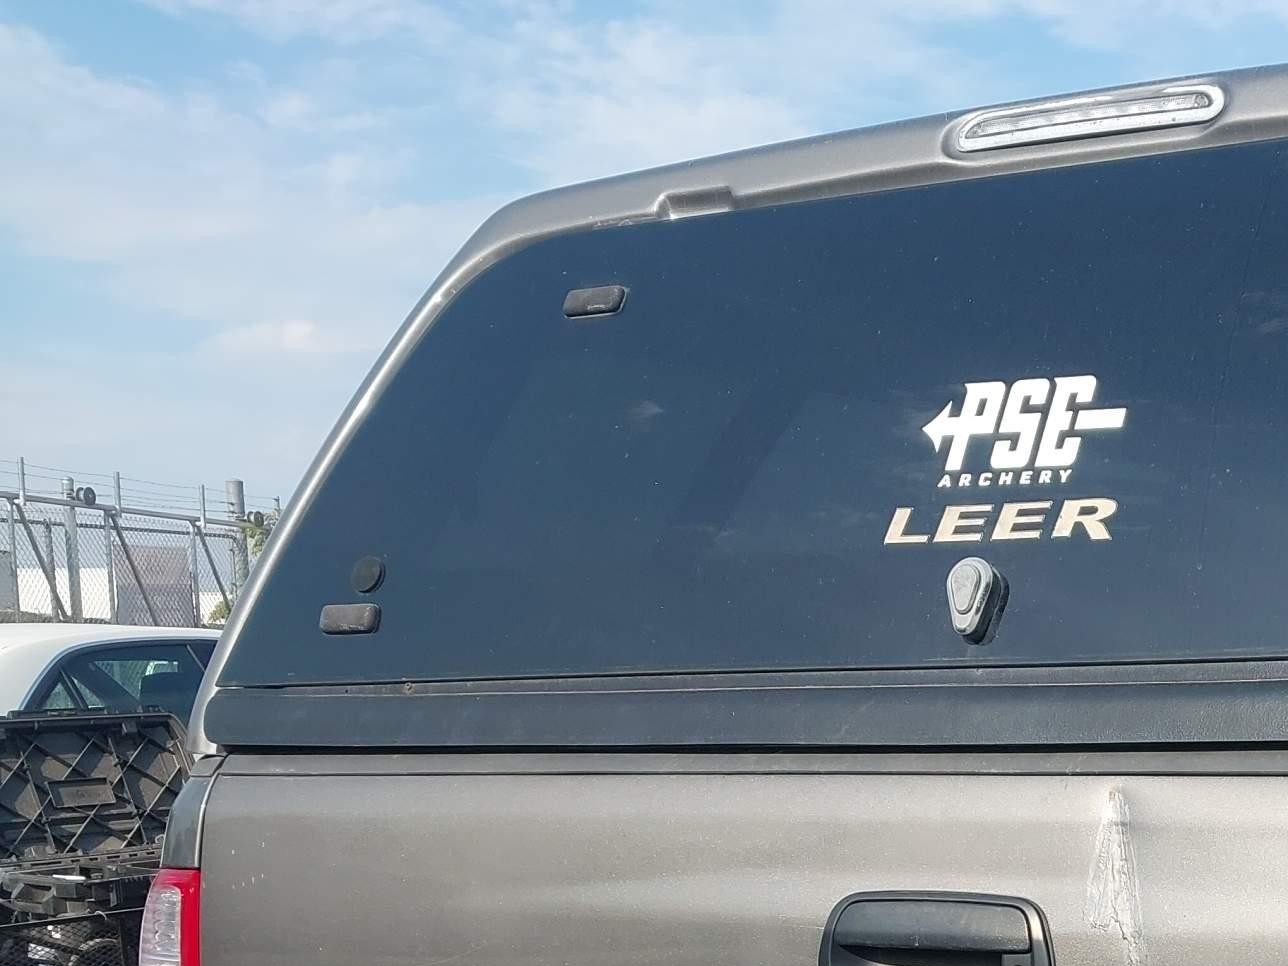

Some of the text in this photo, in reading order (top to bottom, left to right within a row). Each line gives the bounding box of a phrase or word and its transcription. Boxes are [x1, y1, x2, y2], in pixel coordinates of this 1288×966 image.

[936, 375, 1112, 471] PSE
[937, 469, 1073, 488] ARCHERY
[883, 498, 1119, 545] LEER
